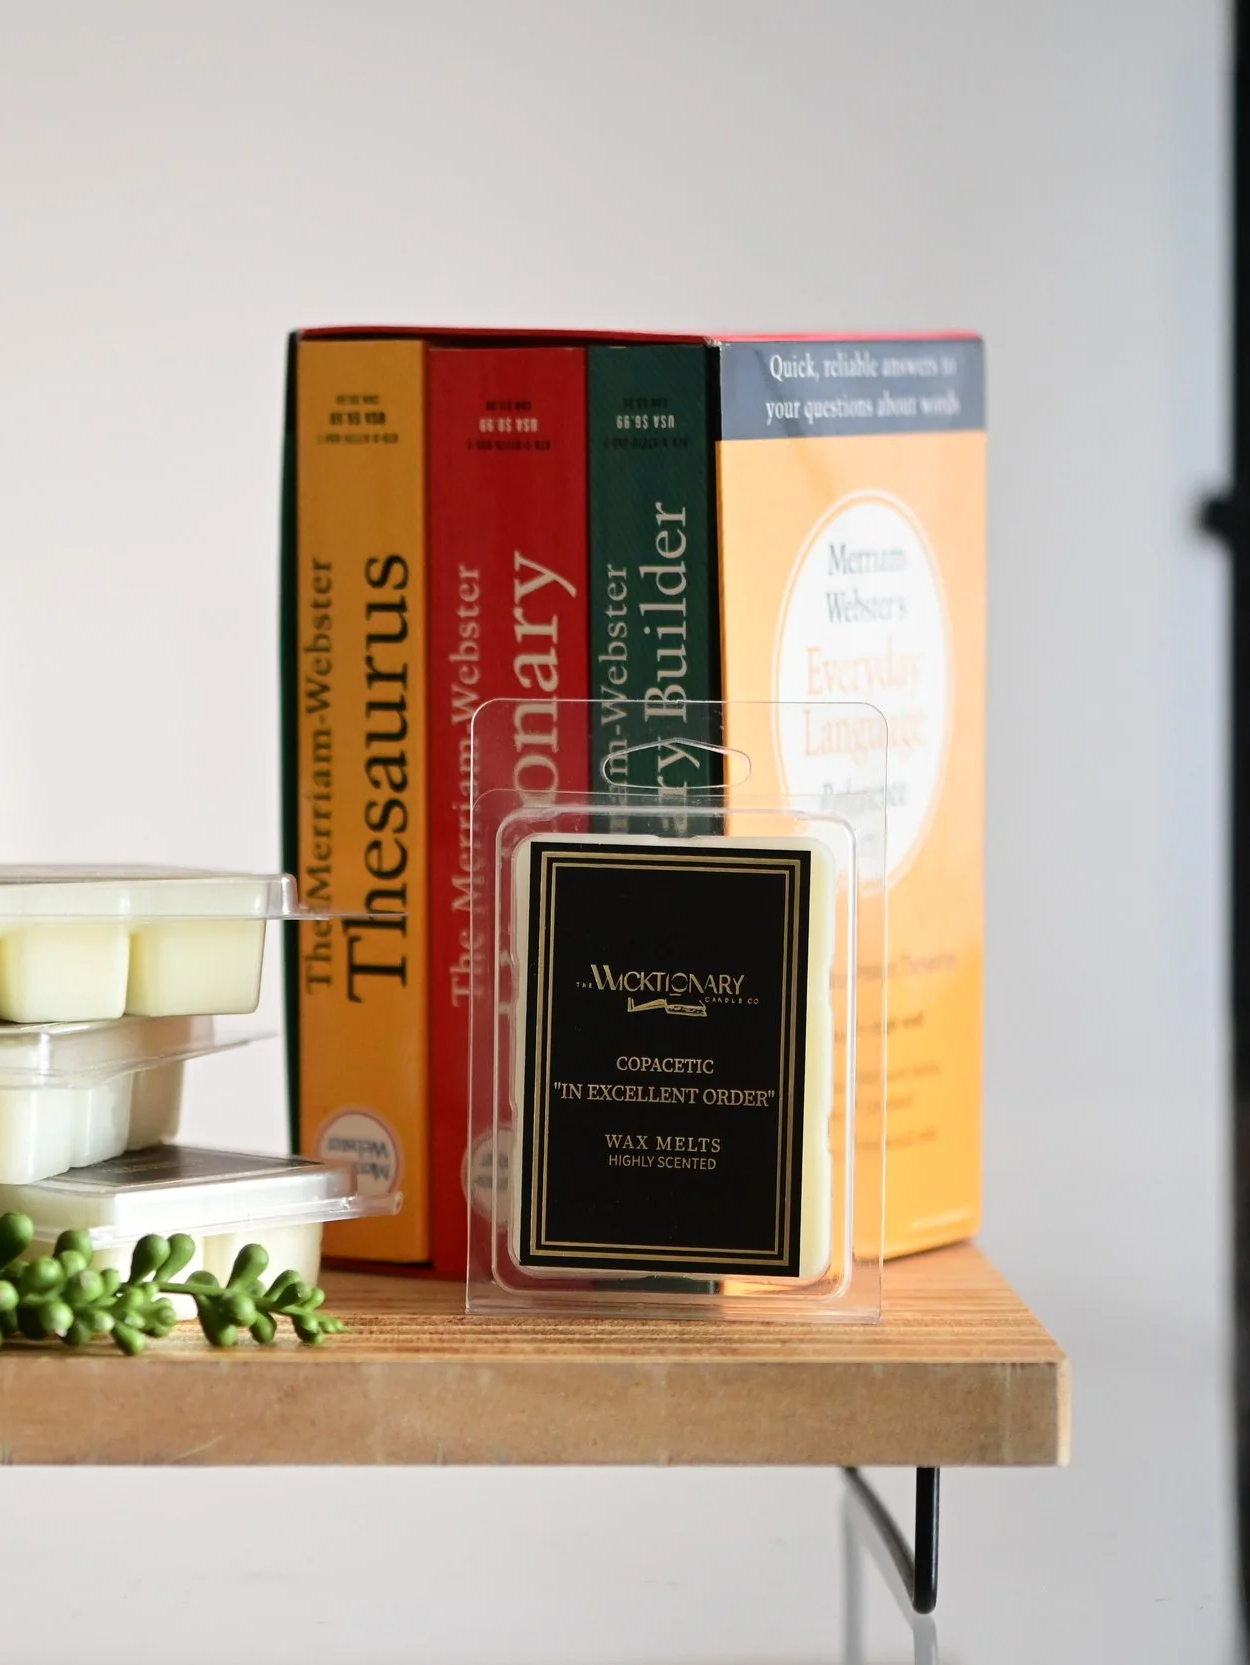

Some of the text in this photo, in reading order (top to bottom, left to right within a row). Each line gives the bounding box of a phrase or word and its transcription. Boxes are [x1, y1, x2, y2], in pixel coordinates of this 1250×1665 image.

[769, 353, 820, 382] Quick,
[823, 351, 879, 378] reliable
[765, 399, 800, 425] your
[803, 393, 873, 424] questions
[876, 390, 917, 417] about
[616, 413, 675, 431] USA $6.99
[638, 502, 688, 723] Builder
[304, 558, 333, 995] The Merriam-Webster
[345, 553, 410, 1003] Thesaurus
[576, 981, 593, 989] THE
[704, 996, 760, 1005] CANDLE CO
[616, 1056, 715, 1074] COPACETIC
[553, 1081, 775, 1107] "IN EXCELLENT ORDER"
[604, 1134, 721, 1153] WAX MELTS
[608, 1154, 717, 1170] HIGHLY SCENTED
